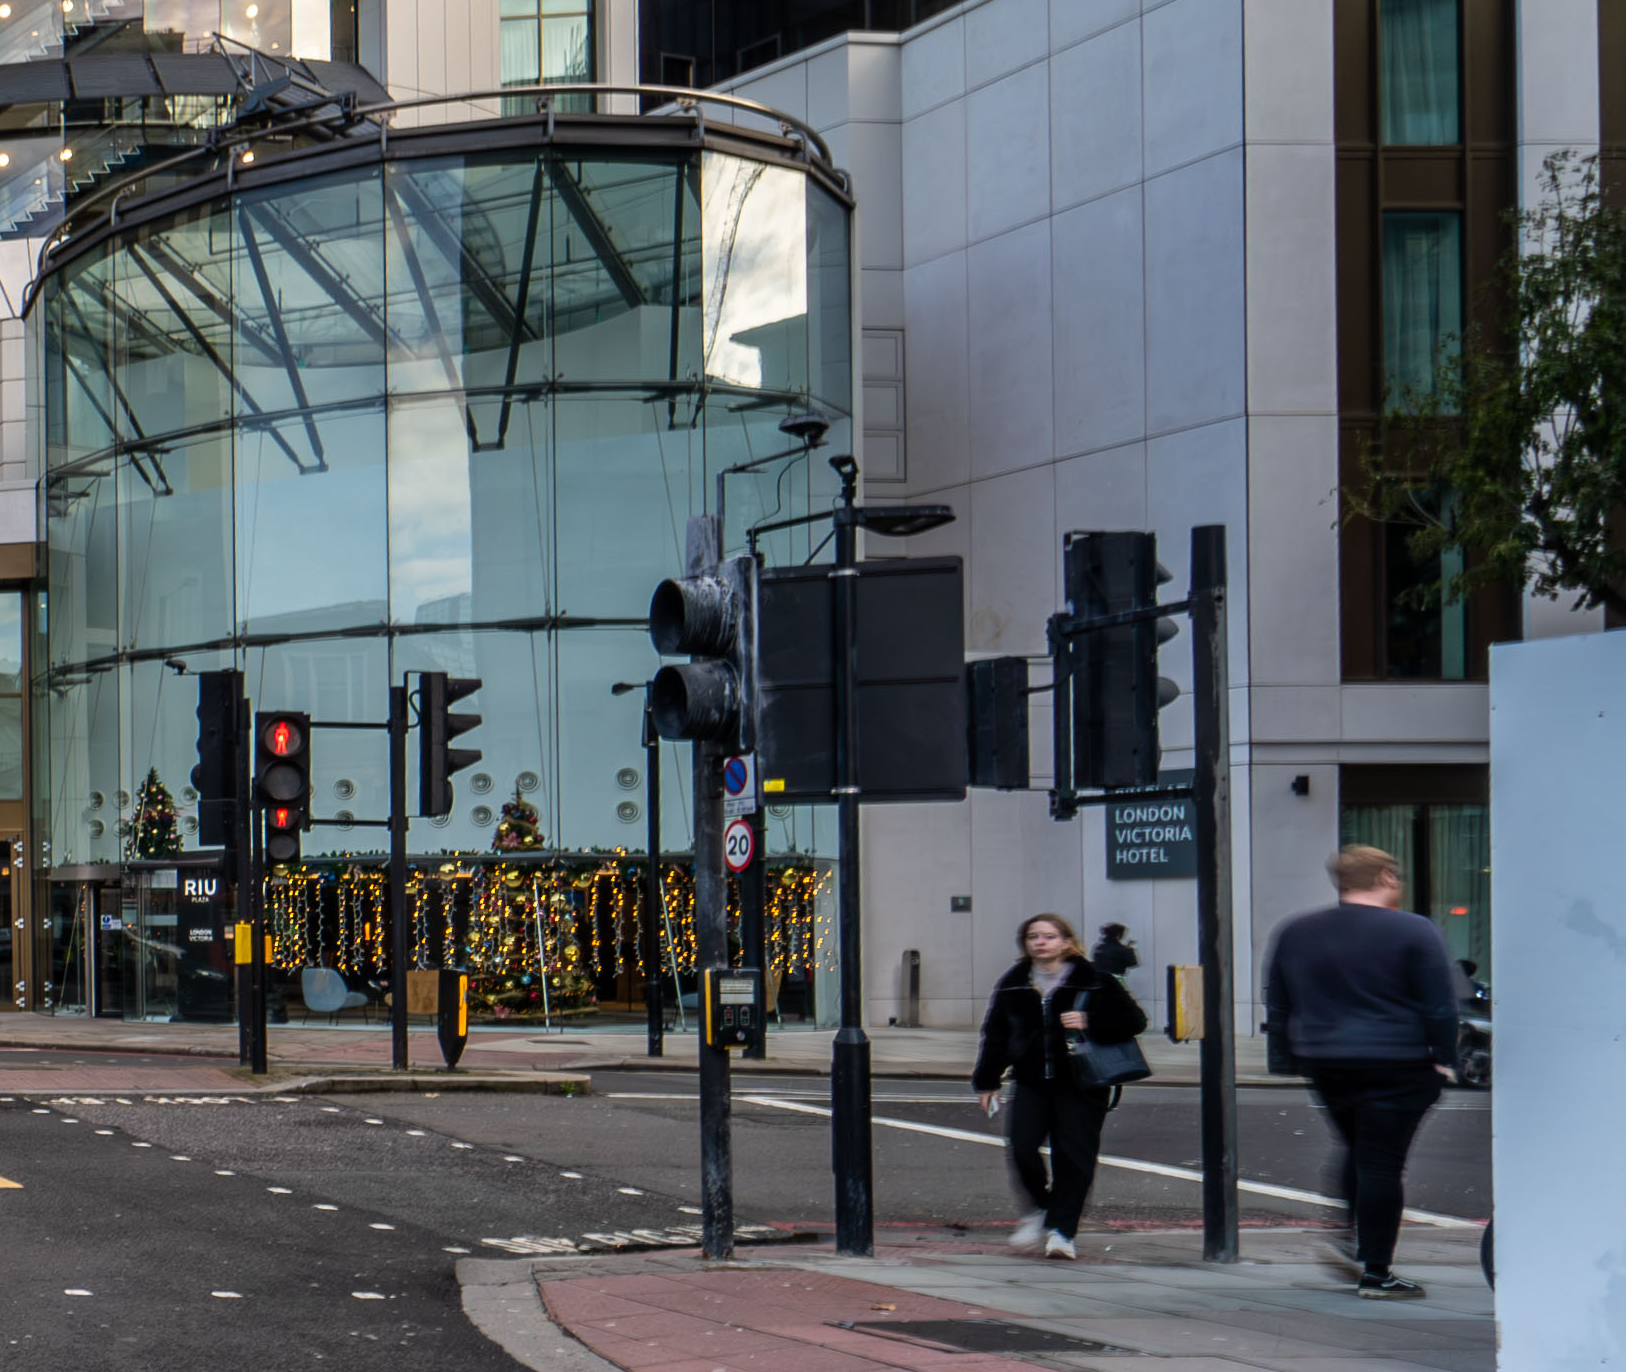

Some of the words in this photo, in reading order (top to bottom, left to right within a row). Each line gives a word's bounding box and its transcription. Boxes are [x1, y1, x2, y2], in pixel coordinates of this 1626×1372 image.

[1115, 805, 1185, 823] LONDON
[1115, 825, 1192, 844] VICTORIA
[728, 834, 750, 856] 20
[1115, 847, 1168, 864] HOTEL
[184, 878, 217, 896] RIU
[191, 896, 210, 904] PLAZA
